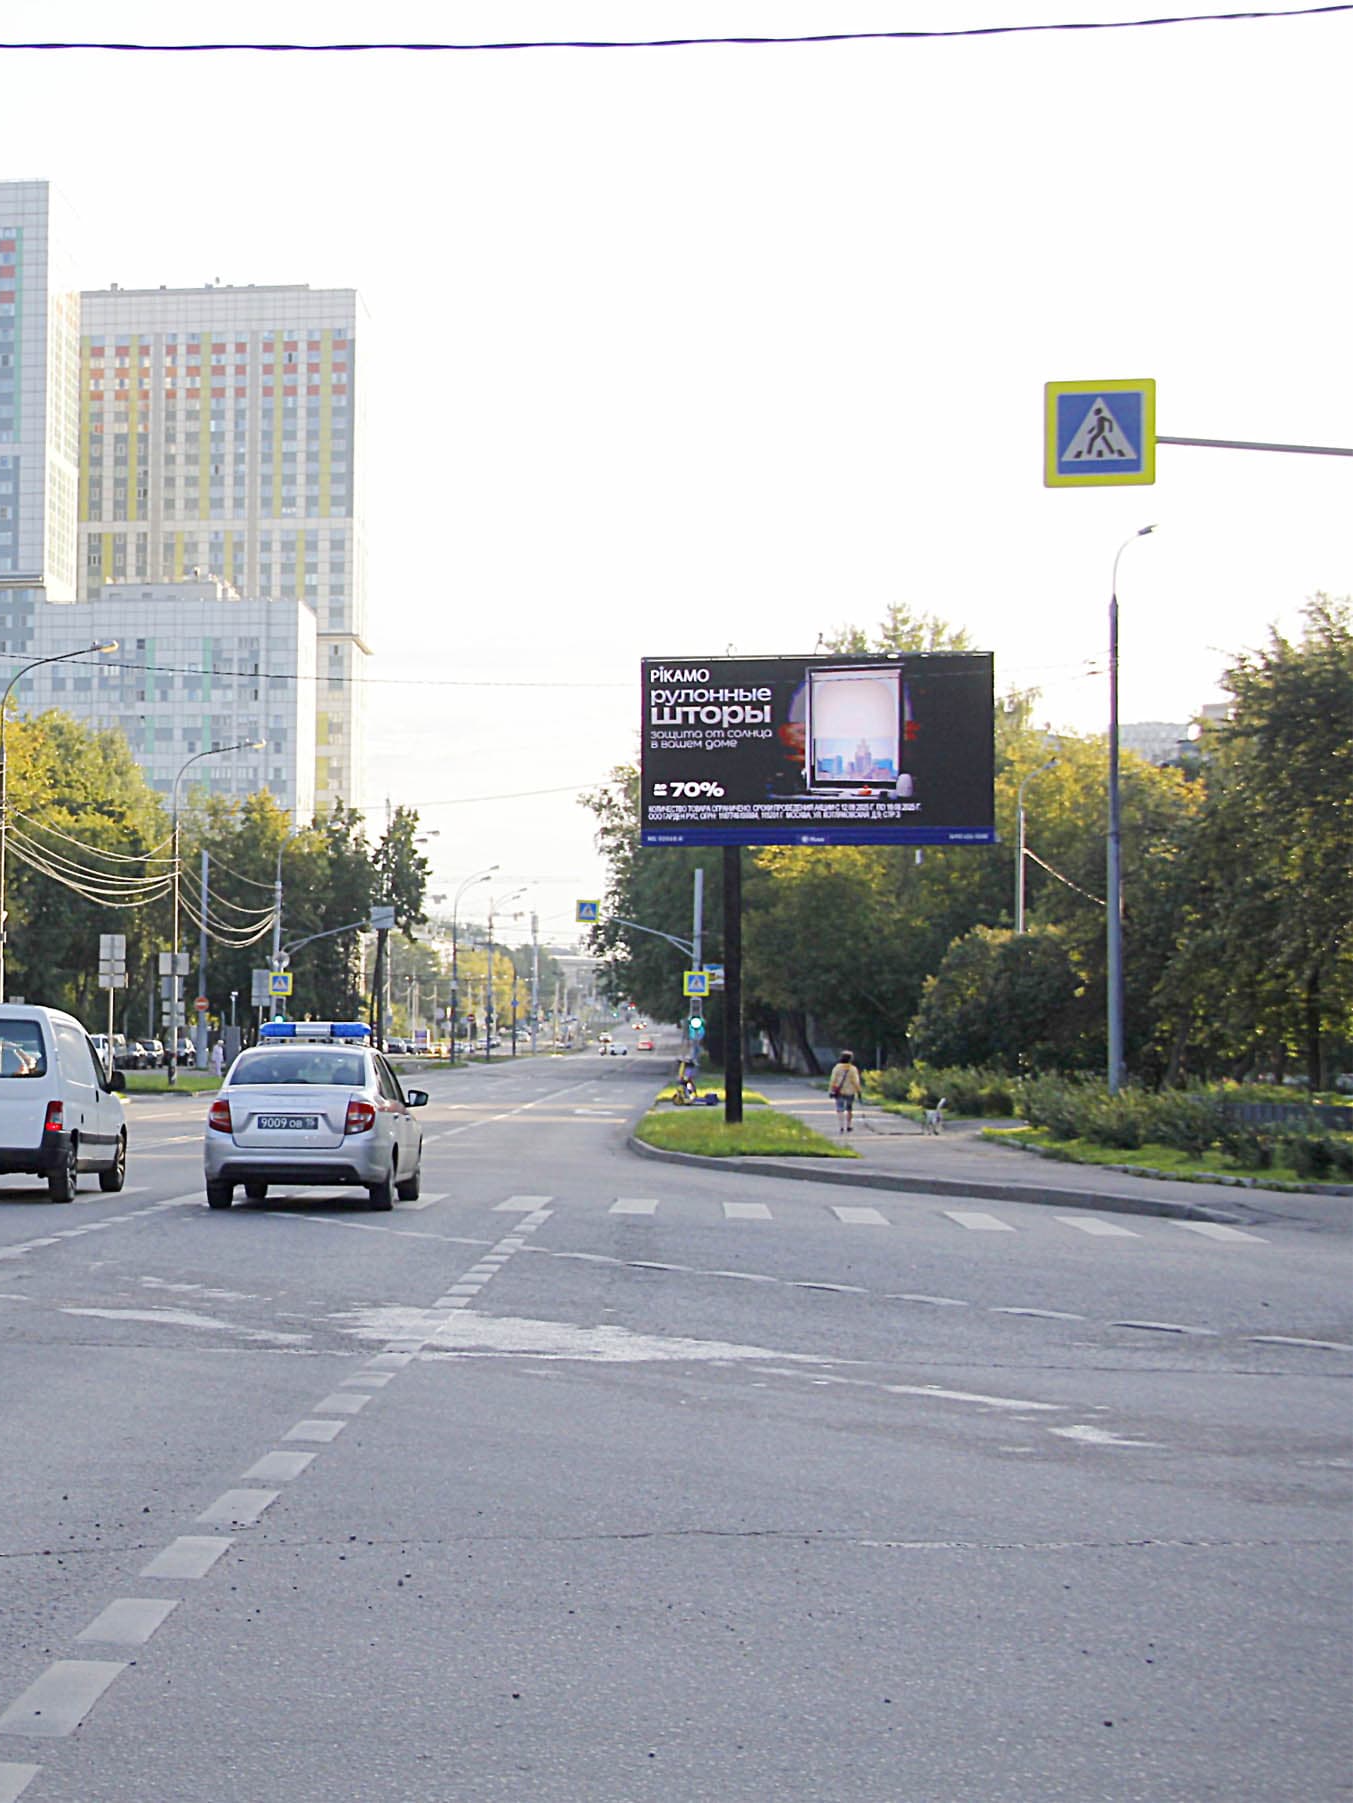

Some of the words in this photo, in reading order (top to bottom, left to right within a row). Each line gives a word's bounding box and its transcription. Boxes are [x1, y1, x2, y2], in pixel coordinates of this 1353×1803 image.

[651, 687, 772, 706] рулонные
[651, 705, 772, 728] шторы
[650, 730, 702, 740] защита
[705, 730, 724, 738] от
[727, 729, 772, 739] солнца
[651, 740, 658, 749] в
[661, 740, 702, 749] вашем
[705, 739, 738, 750] доме
[261, 1117, 287, 1128] 9009
